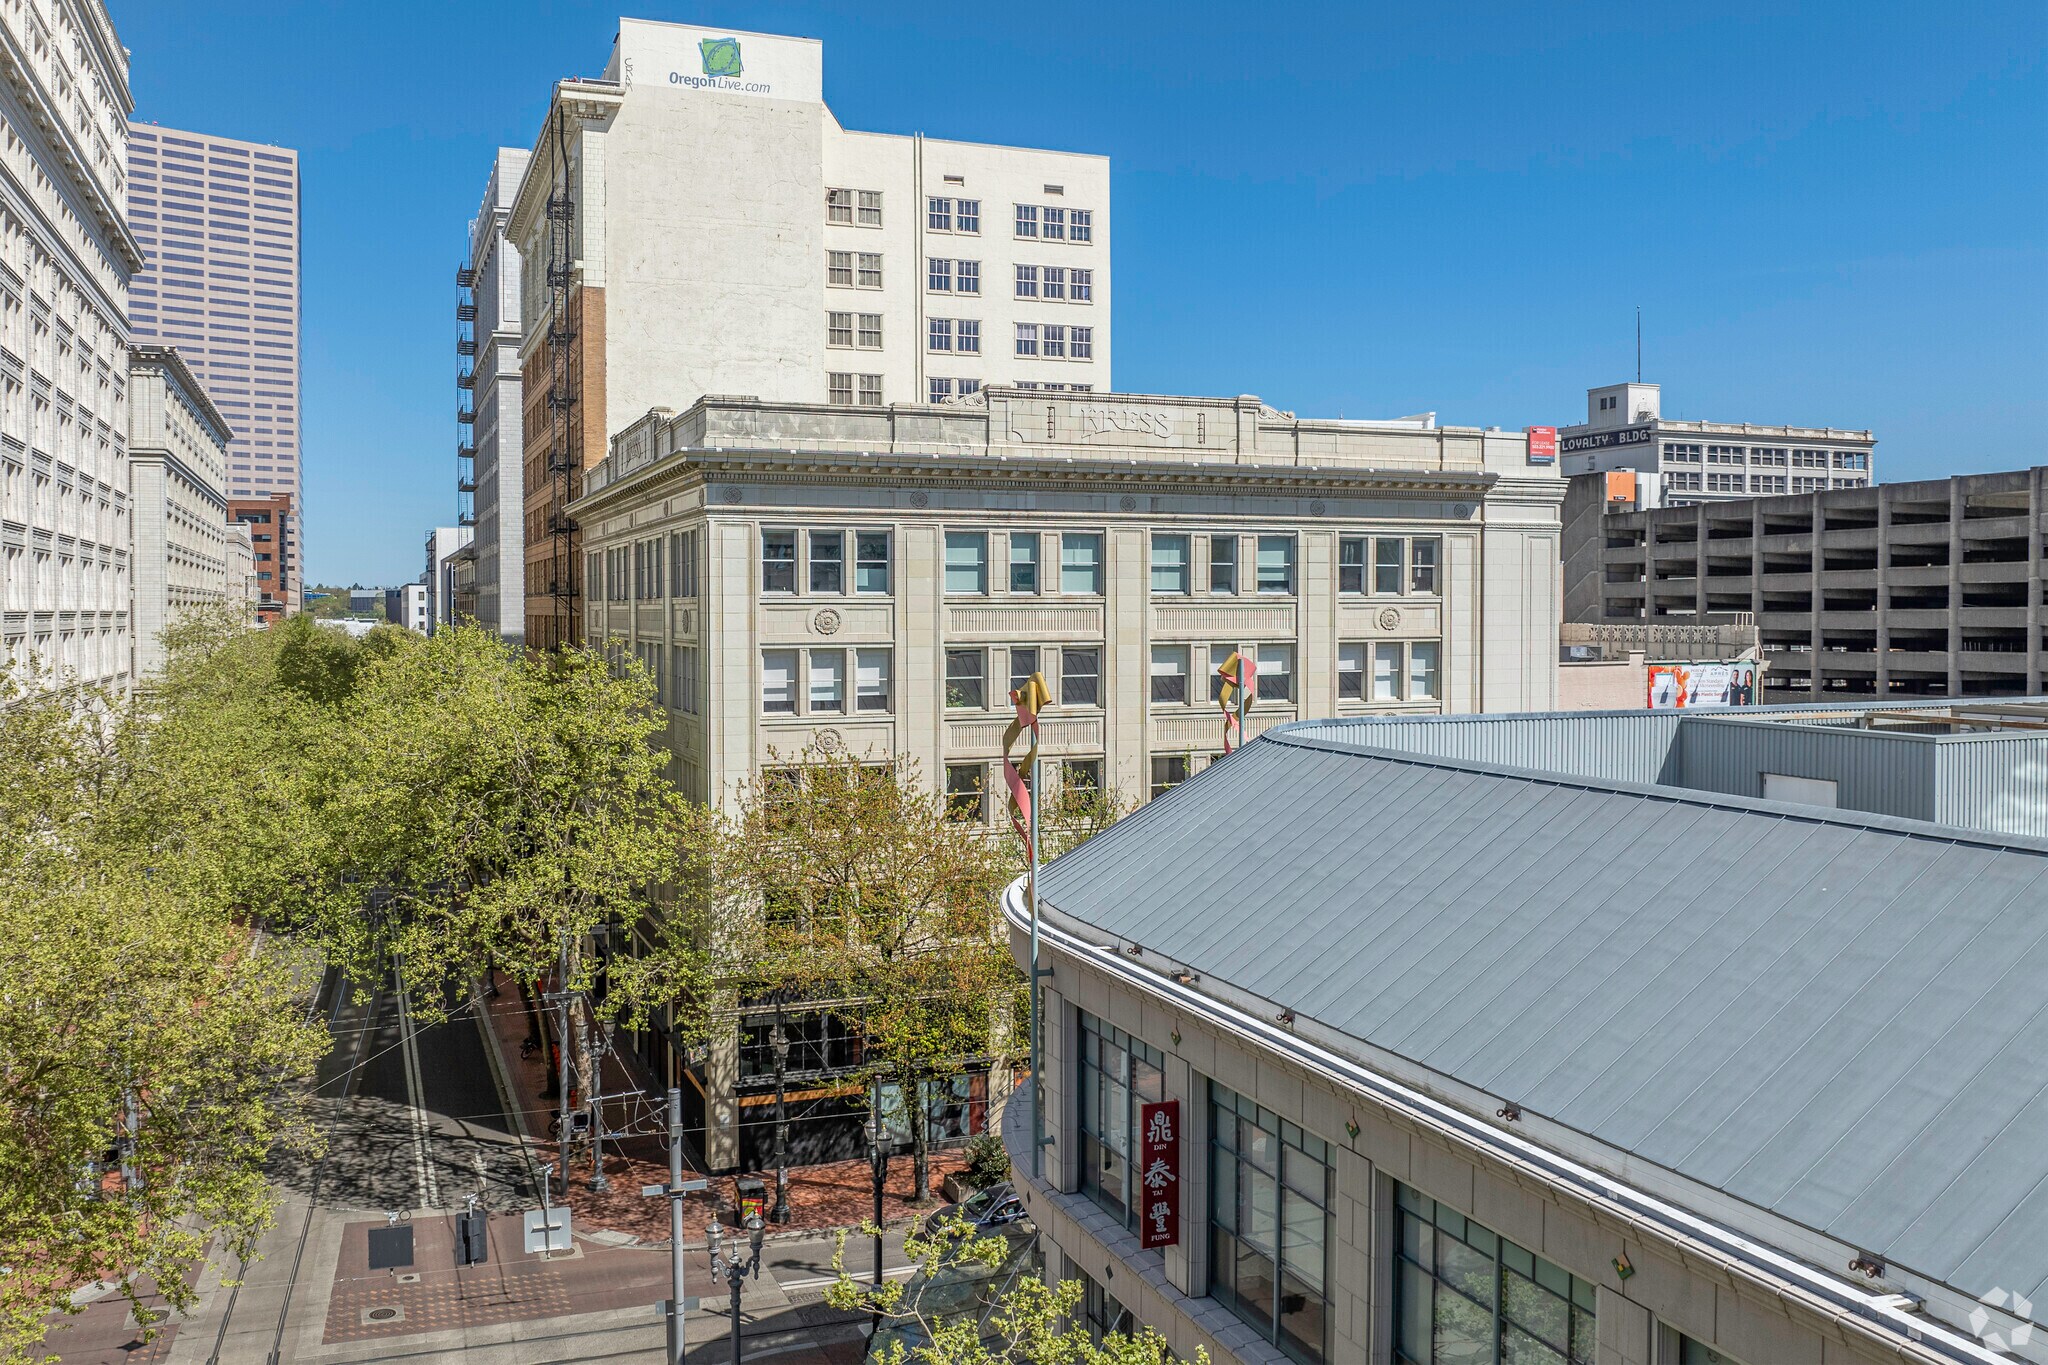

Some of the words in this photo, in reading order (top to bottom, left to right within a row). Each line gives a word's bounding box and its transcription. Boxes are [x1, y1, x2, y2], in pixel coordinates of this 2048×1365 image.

[669, 72, 770, 94] OregonLive.com
[1081, 407, 1173, 439] KRESS
[1562, 434, 1609, 451] LOYALTY
[1147, 1110, 1174, 1143] 鼎
[1153, 1143, 1167, 1151] DIN
[1144, 1157, 1176, 1188] 泰
[1151, 1233, 1170, 1242] FUNG
